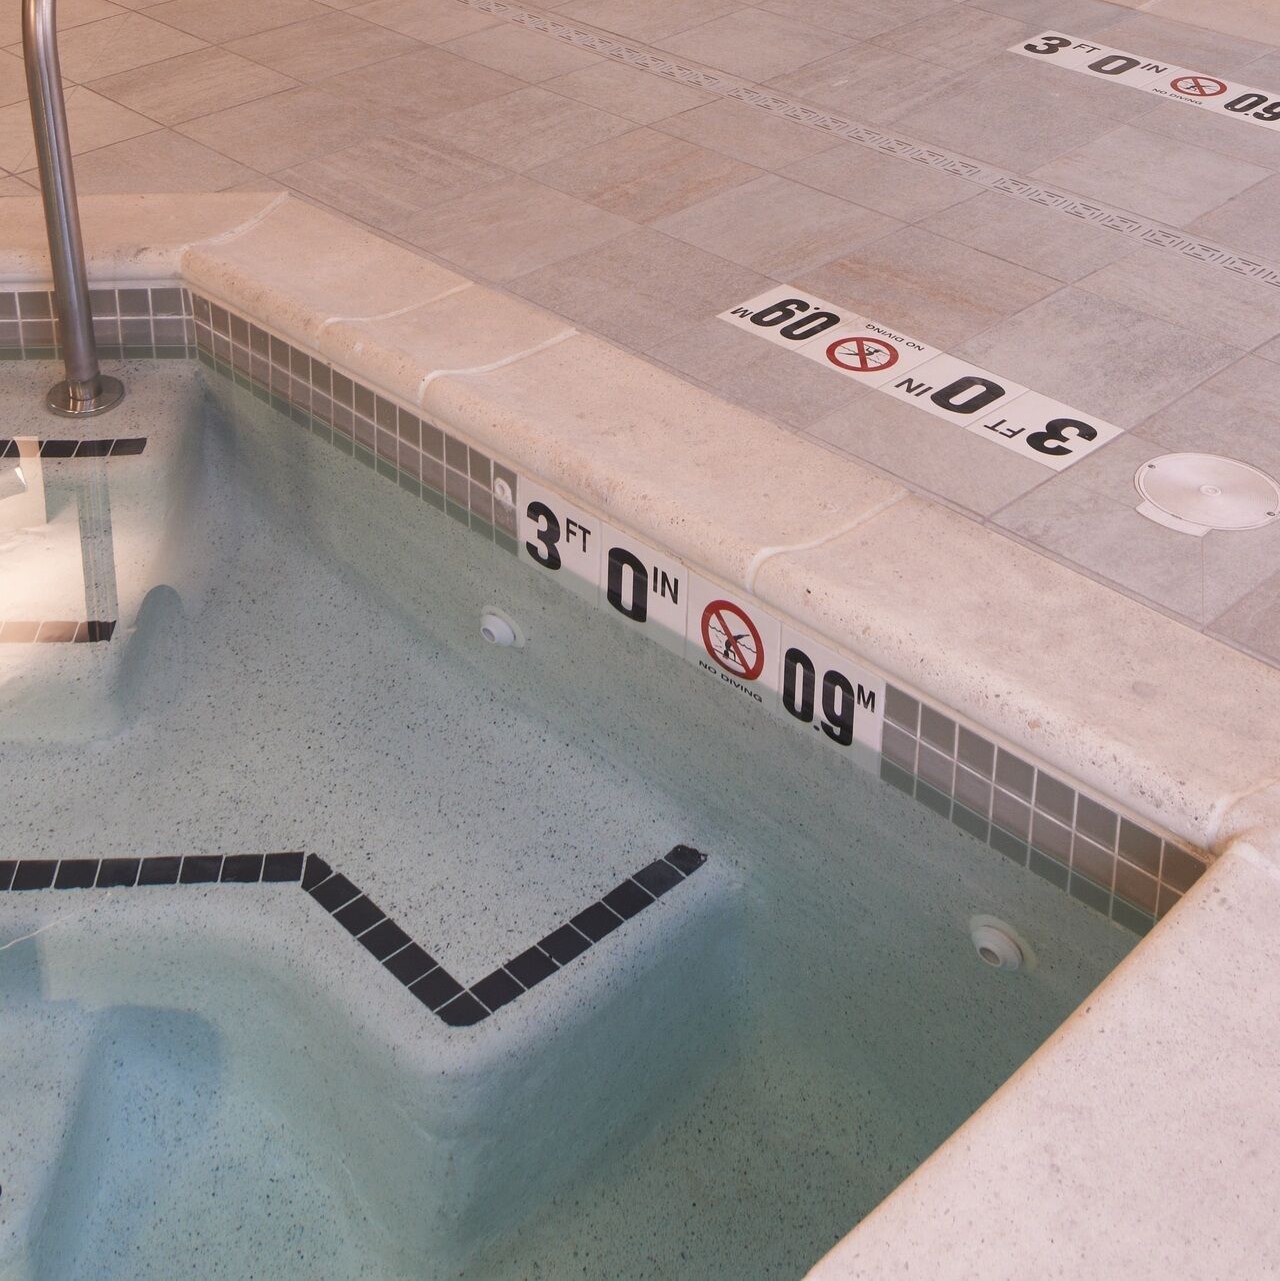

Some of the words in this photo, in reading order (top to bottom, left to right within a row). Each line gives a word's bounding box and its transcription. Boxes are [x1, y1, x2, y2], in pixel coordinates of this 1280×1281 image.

[1023, 36, 1072, 55] 3
[1072, 43, 1102, 54] FT
[1087, 54, 1141, 76] 0
[1140, 62, 1169, 74] IN
[1151, 87, 1168, 95] NO
[1169, 93, 1204, 106] DIVING
[730, 305, 753, 319] M
[749, 298, 841, 341] 0.9
[865, 322, 906, 344] DIVING
[905, 340, 925, 352] NO
[894, 377, 934, 398] IN
[929, 375, 1007, 415] 0
[984, 419, 1026, 440] FT
[1025, 417, 1098, 457] 3
[525, 500, 561, 571] 3
[565, 517, 591, 554] FT
[607, 546, 648, 623] 0
[652, 565, 679, 605] IN
[782, 647, 855, 747] 0.9
[856, 683, 876, 713] M
[699, 659, 717, 675] NO
[720, 673, 762, 704] DIVING
